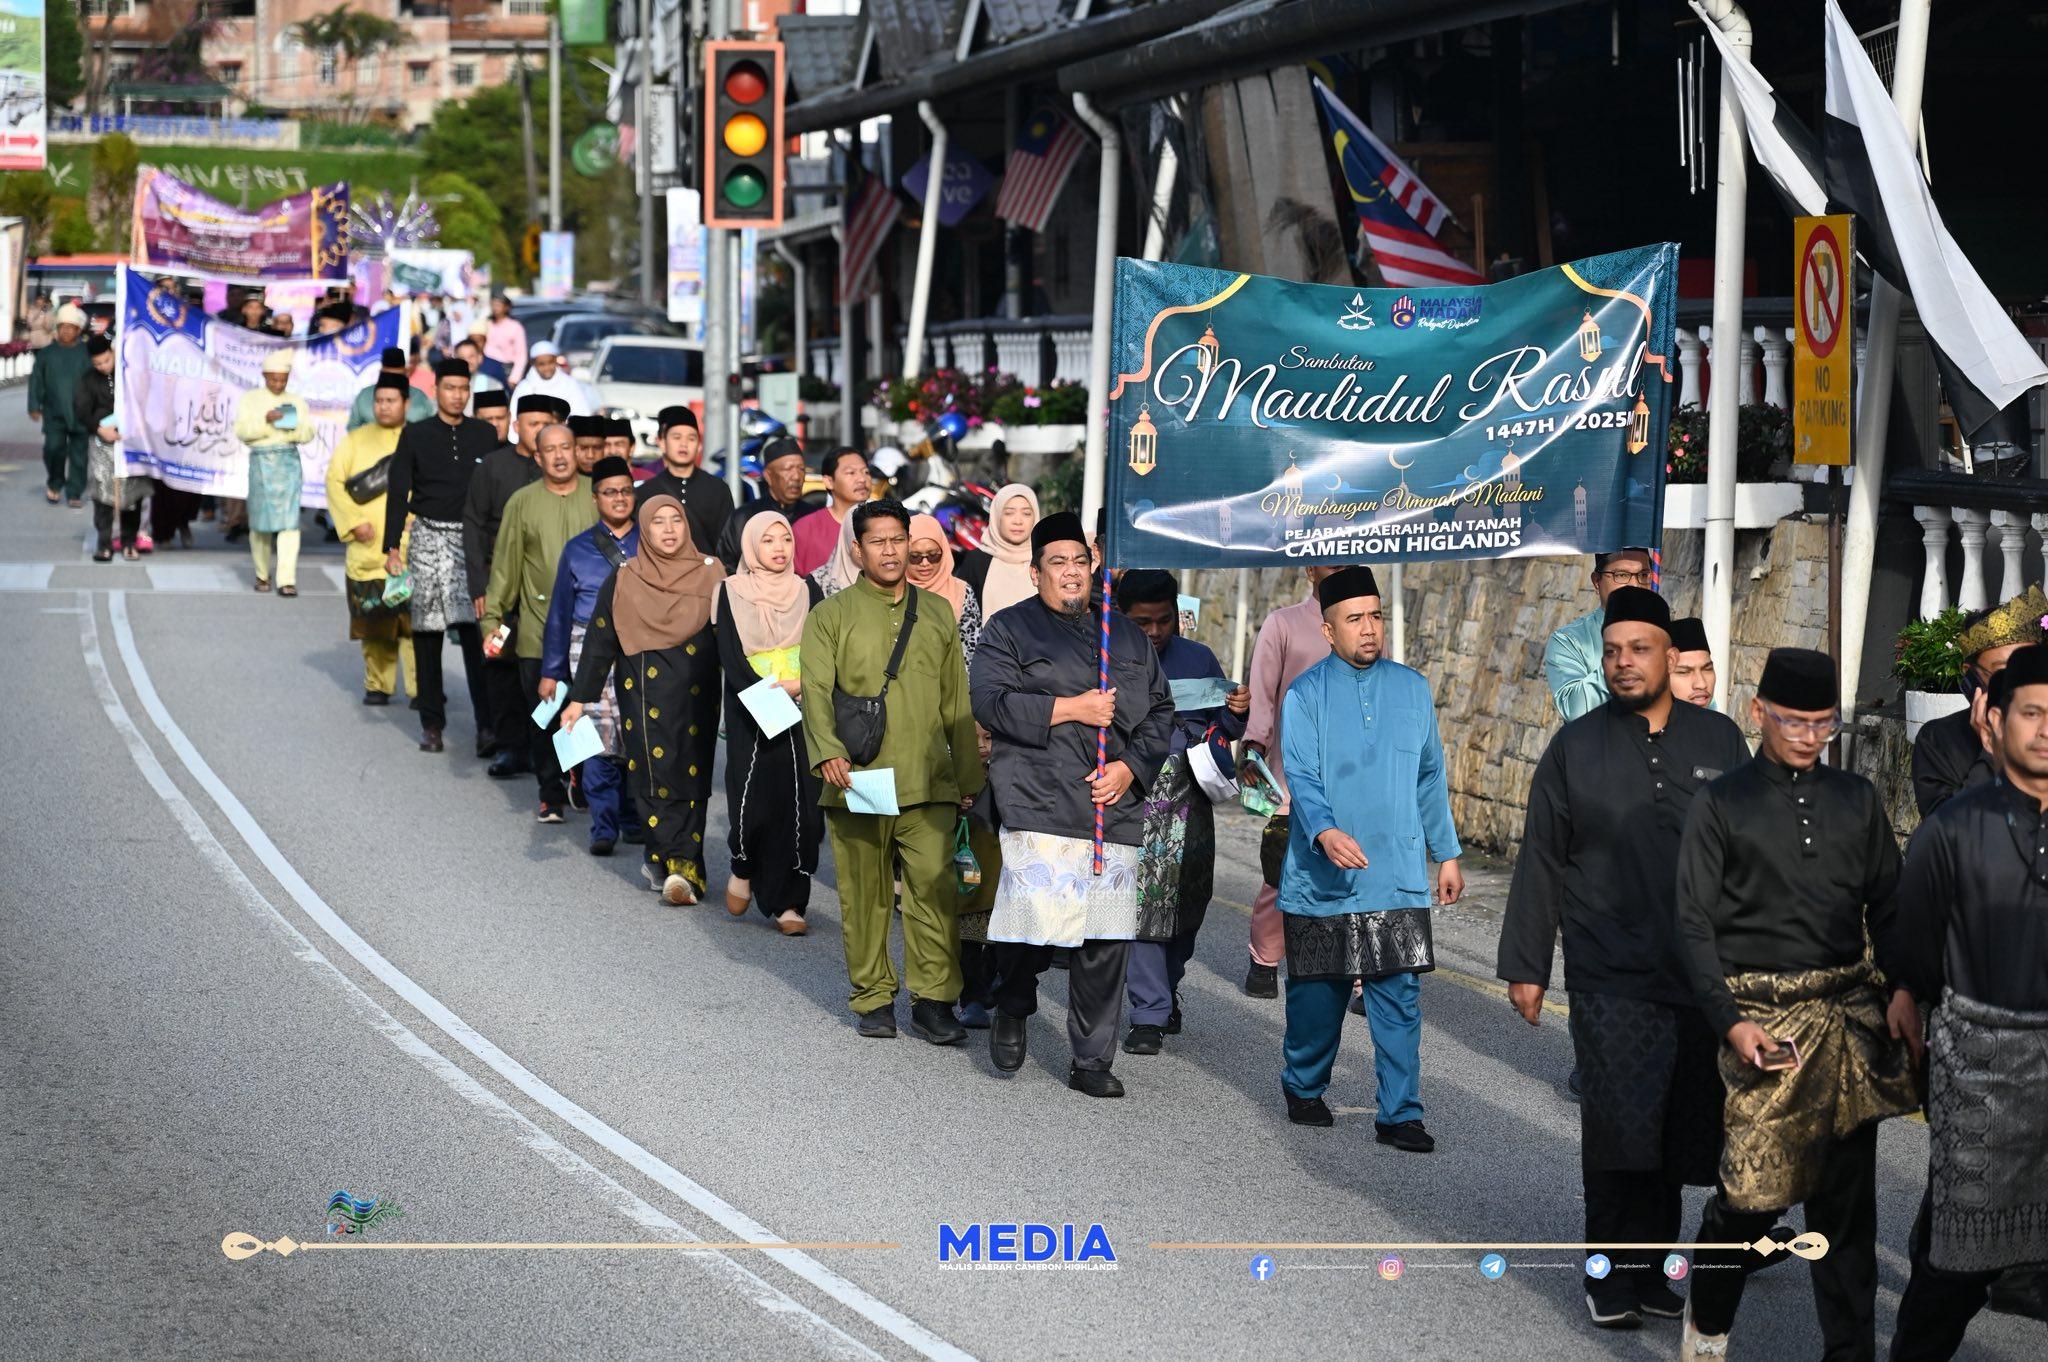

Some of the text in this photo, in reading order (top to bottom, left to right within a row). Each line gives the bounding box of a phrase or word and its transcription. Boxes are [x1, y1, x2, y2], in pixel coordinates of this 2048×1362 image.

[1279, 346, 1375, 371] Sambutan
[1154, 340, 1647, 428] Maulidul Rasul
[1814, 365, 1831, 393] NO
[1801, 400, 1846, 427] PARKING
[1486, 417, 1555, 441] 1447H
[1261, 481, 1544, 520] Membangun Ummah Madani
[1285, 516, 1522, 541] PEJABAT DAERAH DAN TANAH
[1285, 530, 1521, 558] CAMERON HIGLANDS
